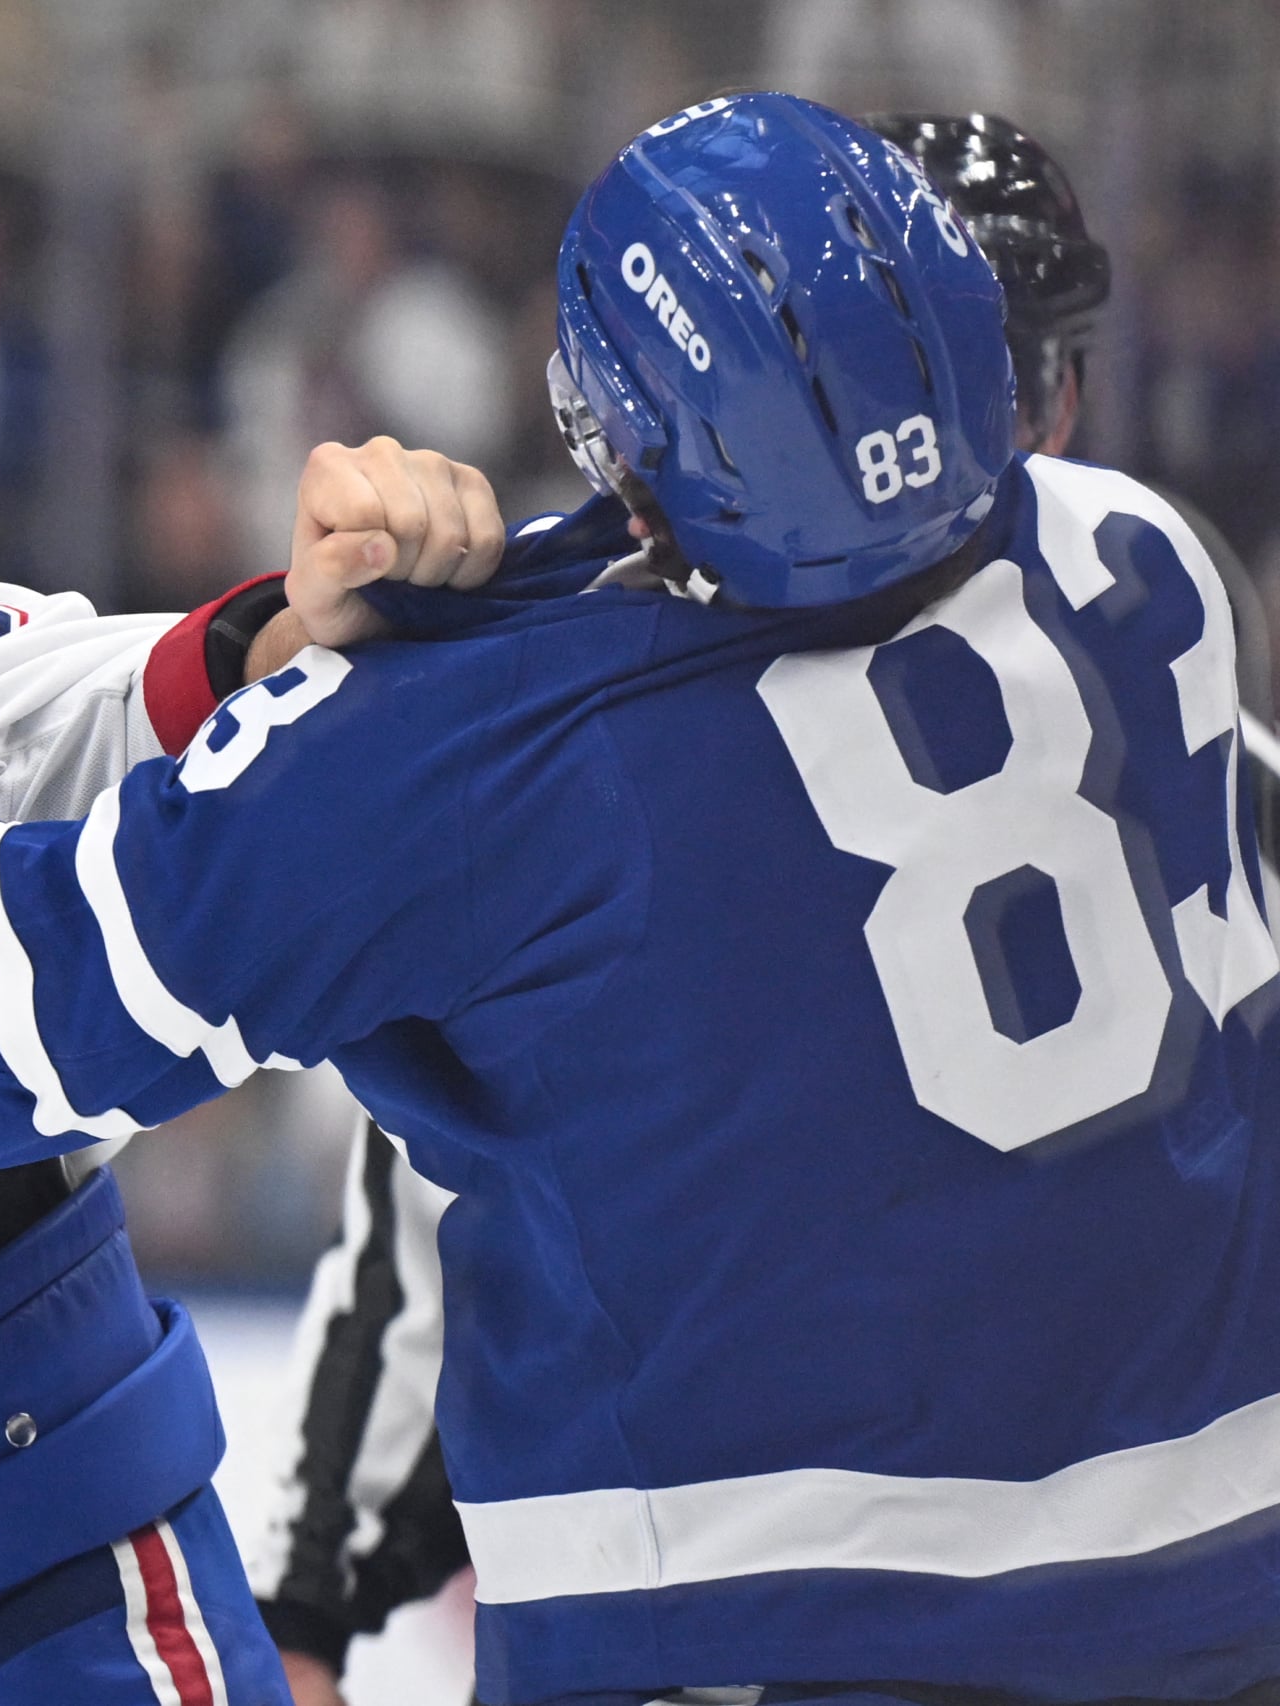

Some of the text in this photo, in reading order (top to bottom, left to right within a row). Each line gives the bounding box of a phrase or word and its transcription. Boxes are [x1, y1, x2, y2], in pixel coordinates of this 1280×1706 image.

[621, 243, 711, 372] OREO
[856, 414, 942, 504] 83
[756, 453, 1279, 1153] 83
